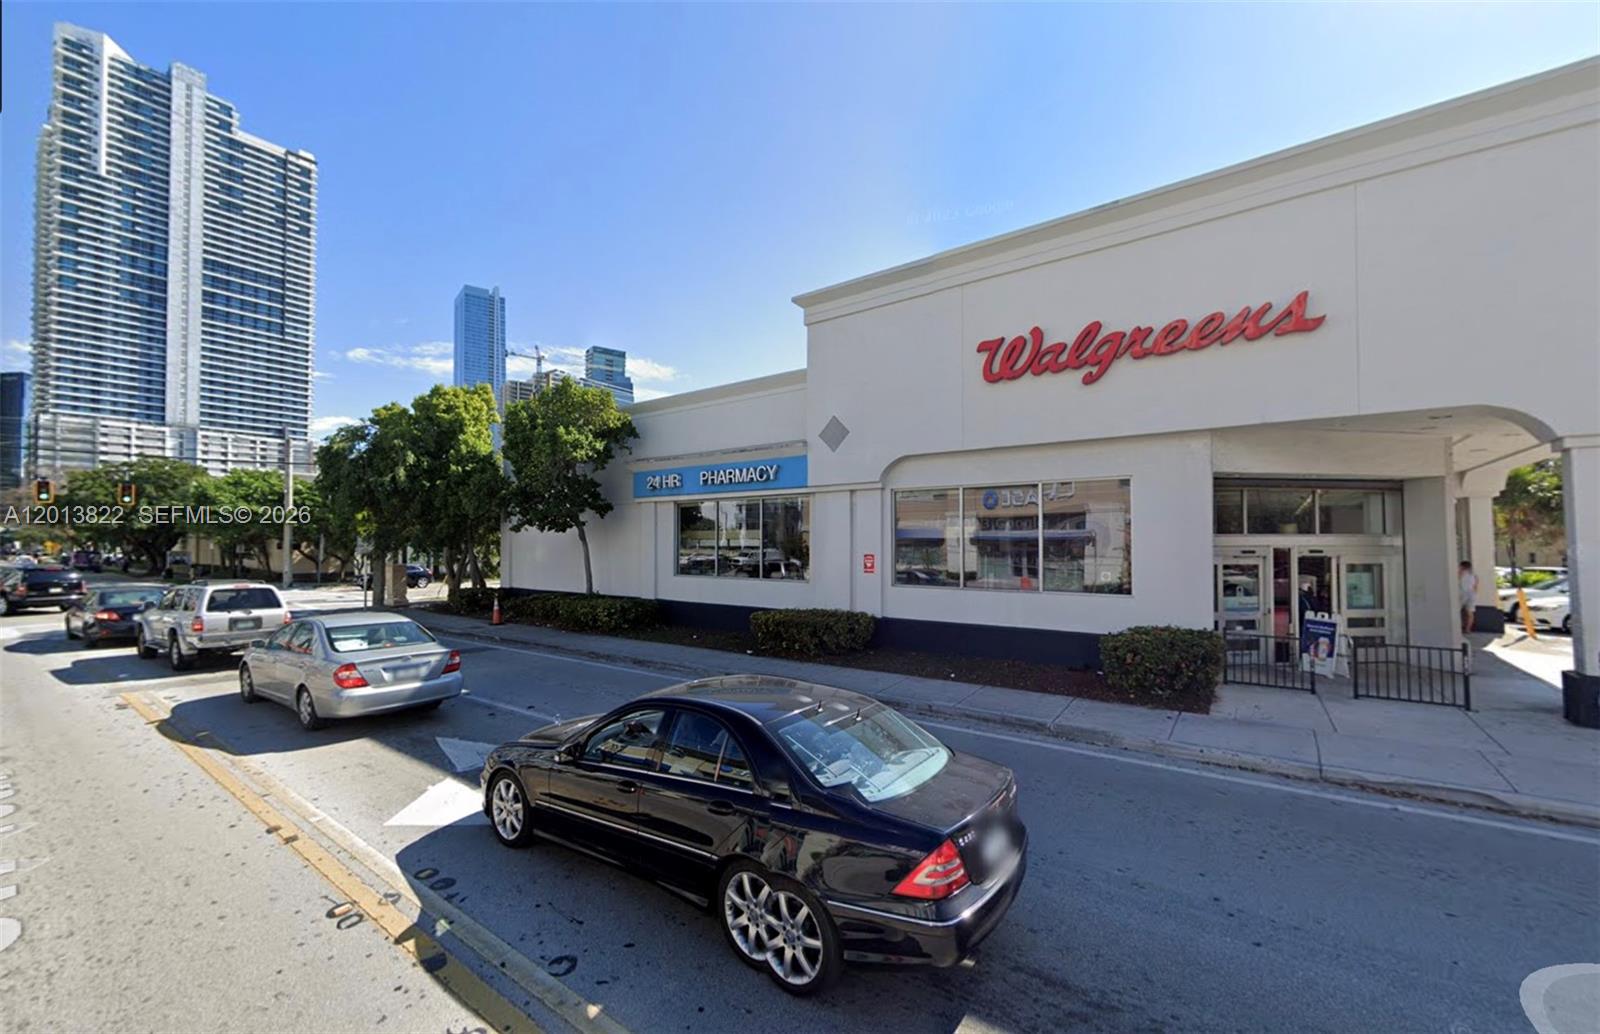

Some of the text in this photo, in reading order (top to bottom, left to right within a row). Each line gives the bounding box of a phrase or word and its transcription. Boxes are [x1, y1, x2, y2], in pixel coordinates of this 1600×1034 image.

[976, 291, 1327, 386] Walgreens
[646, 475, 661, 489] 24
[699, 464, 778, 486] PHARMACY
